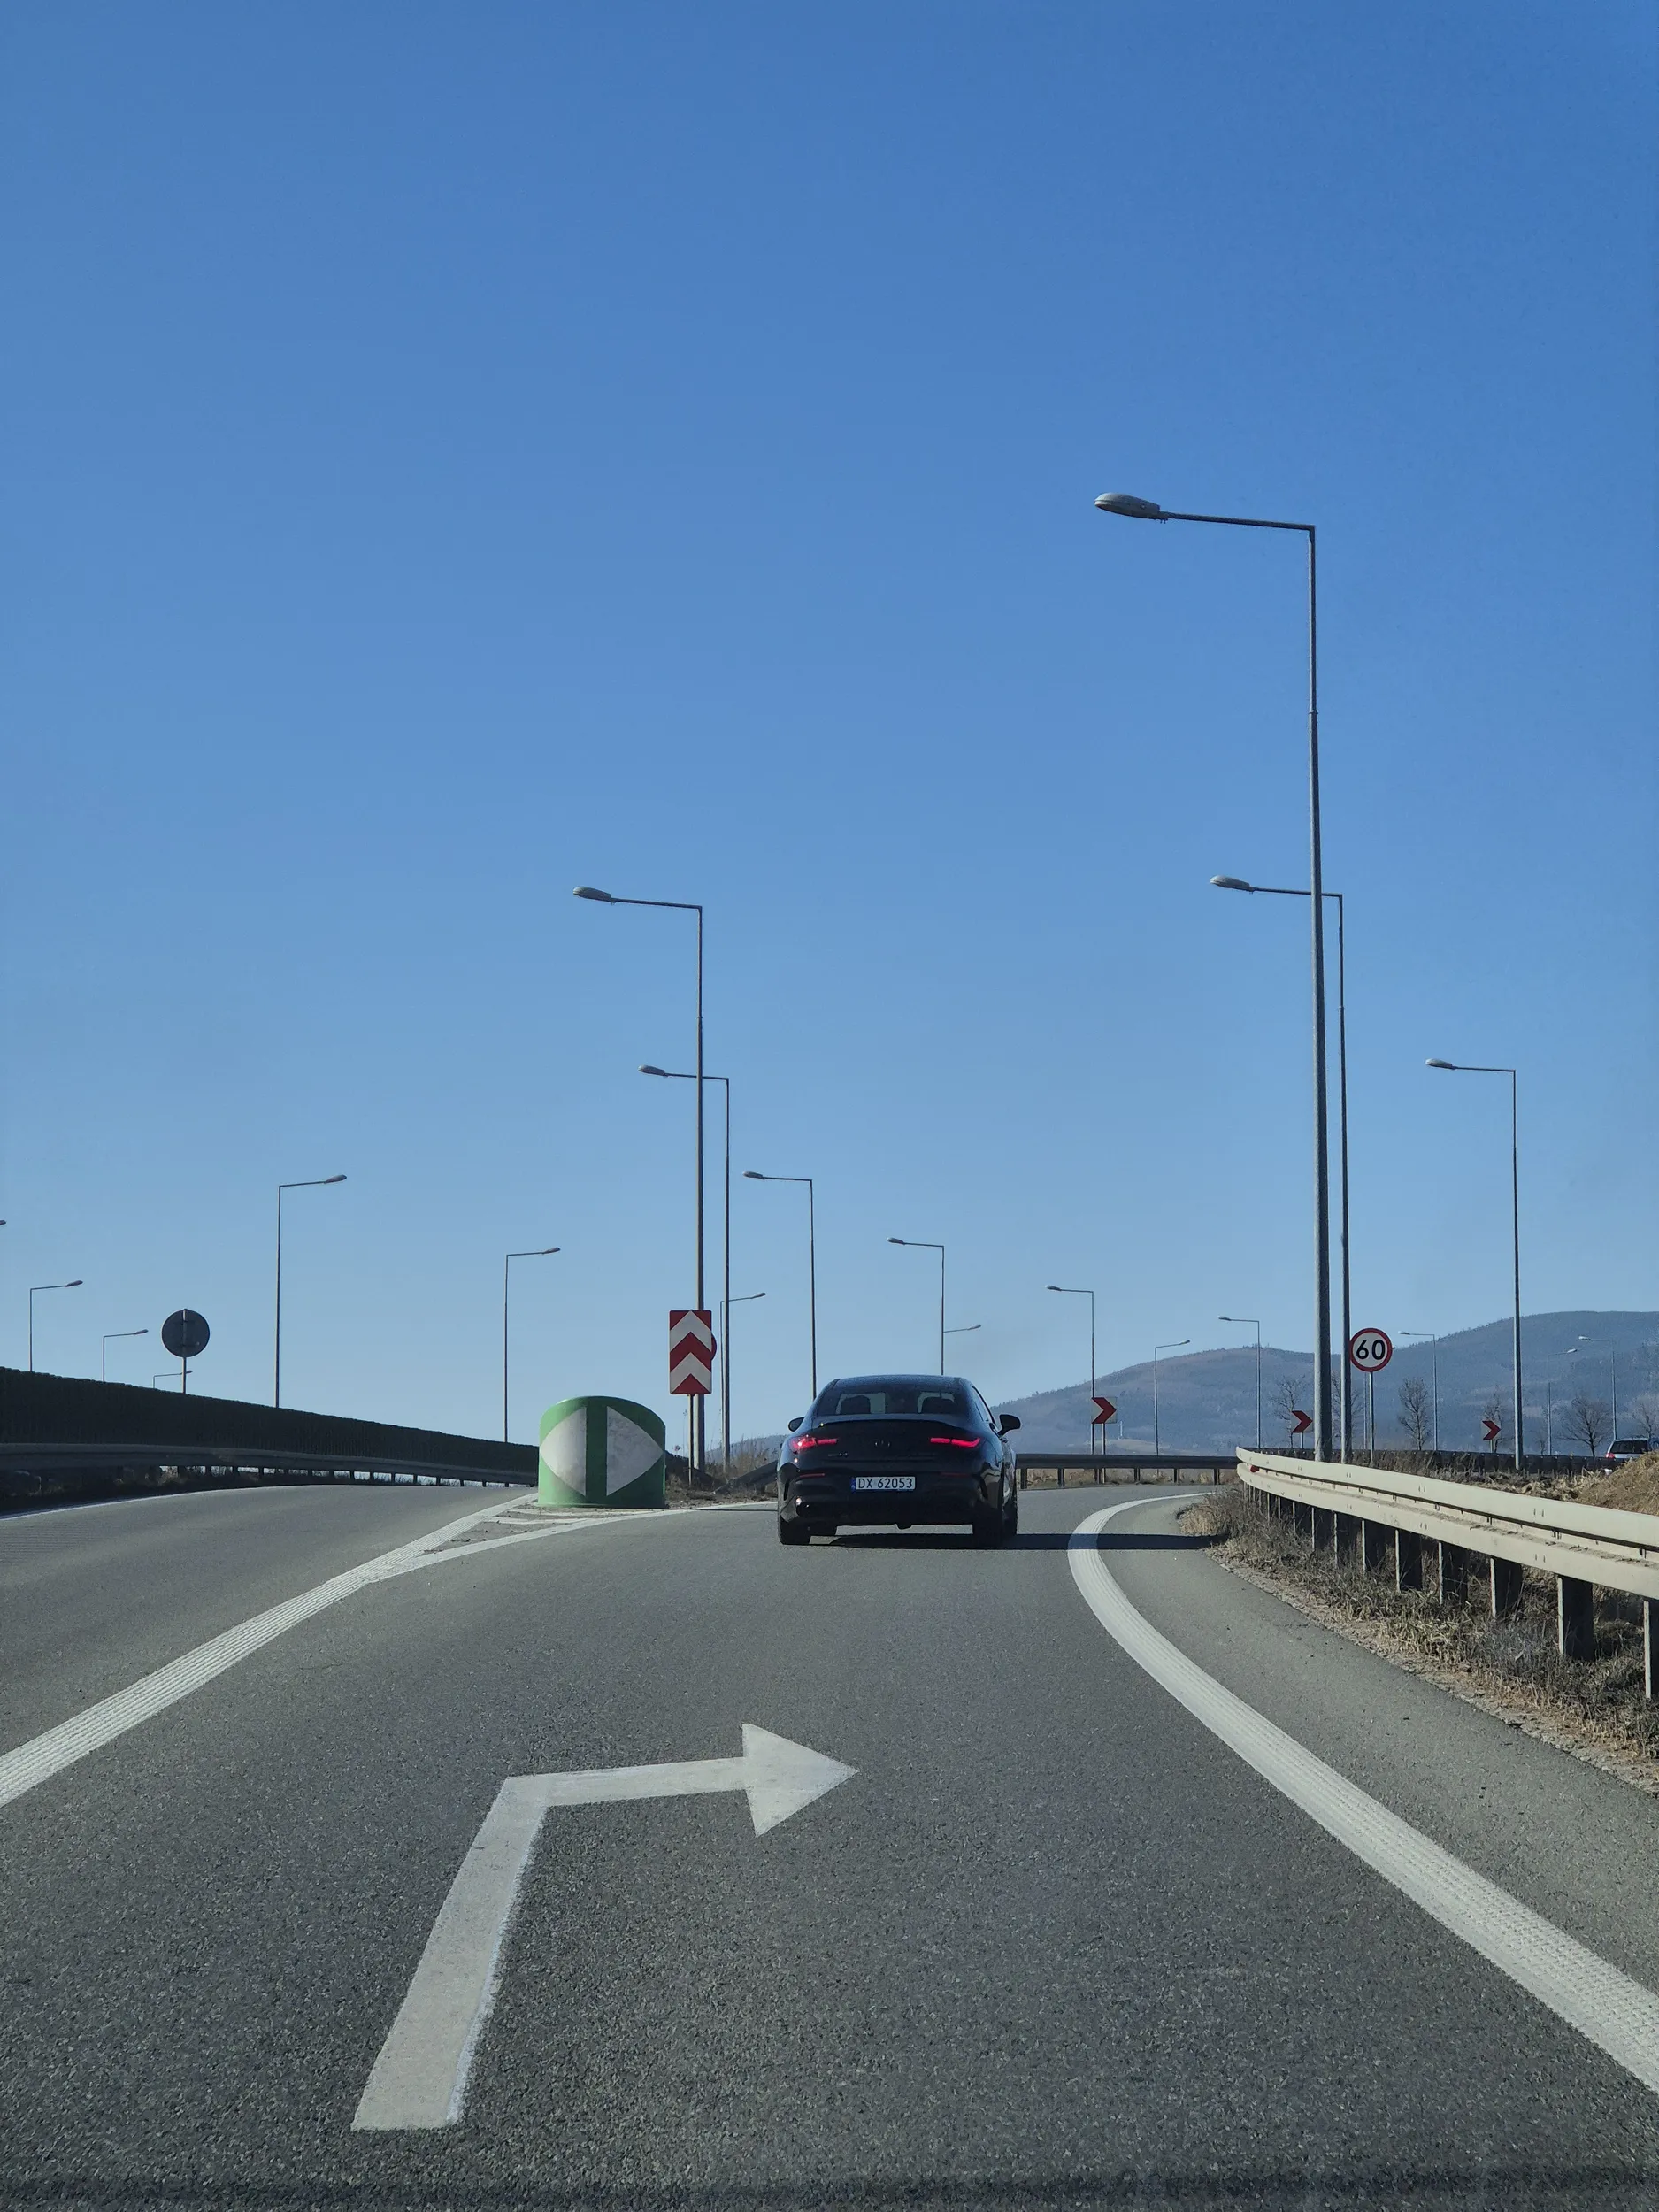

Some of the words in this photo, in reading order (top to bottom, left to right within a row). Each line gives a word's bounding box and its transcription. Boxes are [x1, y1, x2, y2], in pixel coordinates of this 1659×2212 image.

[1356, 1340, 1386, 1360] 60
[858, 1478, 872, 1488] DX
[877, 1478, 912, 1488] 62053
